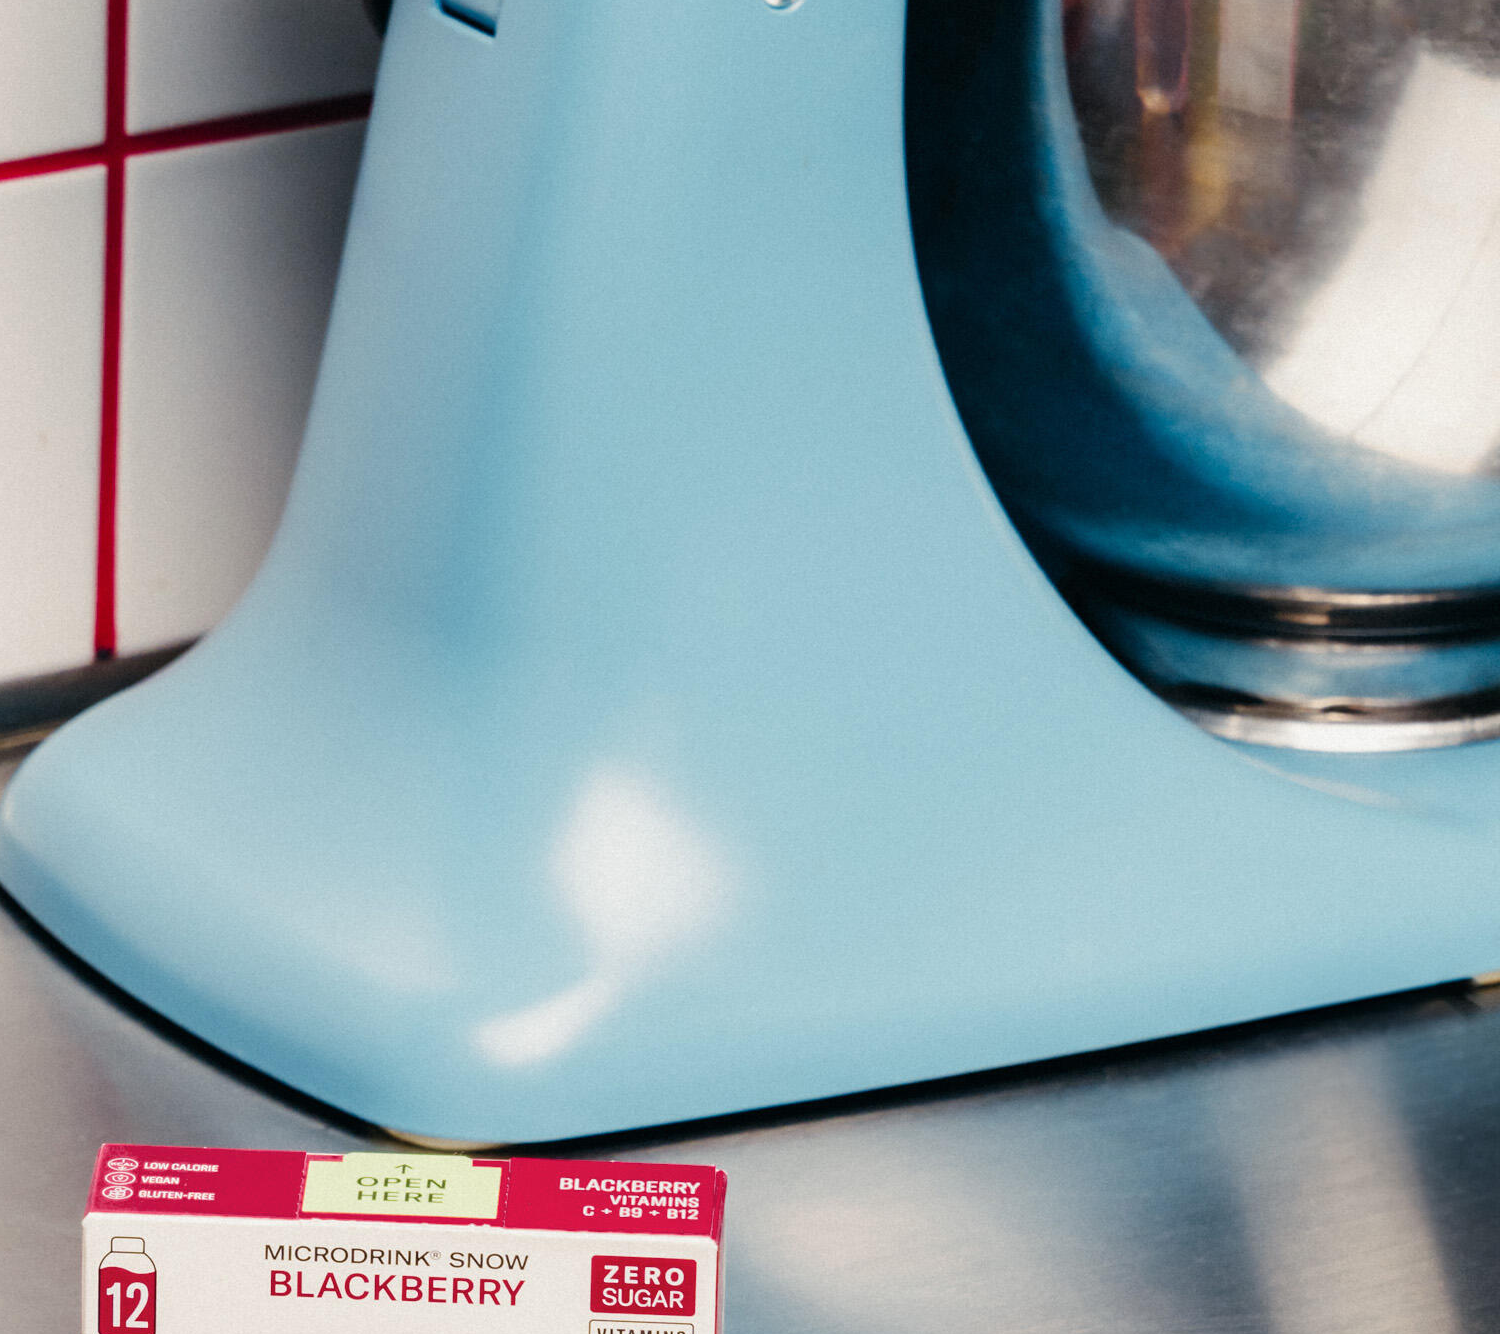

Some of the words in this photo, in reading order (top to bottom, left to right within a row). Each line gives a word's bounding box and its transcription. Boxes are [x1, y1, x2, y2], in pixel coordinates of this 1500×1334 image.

[143, 1162, 170, 1171] LOW
[171, 1163, 219, 1173] CALORIE
[141, 1176, 180, 1185] VEGAN
[356, 1176, 447, 1190] OPEN
[559, 1177, 700, 1195] BLACKBERRY
[138, 1190, 216, 1201] GLUTEN-FREE
[356, 1190, 445, 1204] HERE
[609, 1194, 700, 1208] VITAMINS
[582, 1205, 595, 1217] C
[600, 1207, 613, 1216] +
[619, 1206, 643, 1219] B9
[648, 1208, 661, 1217] +
[666, 1207, 700, 1220] B12
[449, 1251, 529, 1270] SNOW
[603, 1264, 685, 1286] ZERO
[269, 1269, 526, 1306] BLACKBERRY
[106, 1281, 149, 1328] 12
[601, 1287, 685, 1309] SUGAR
